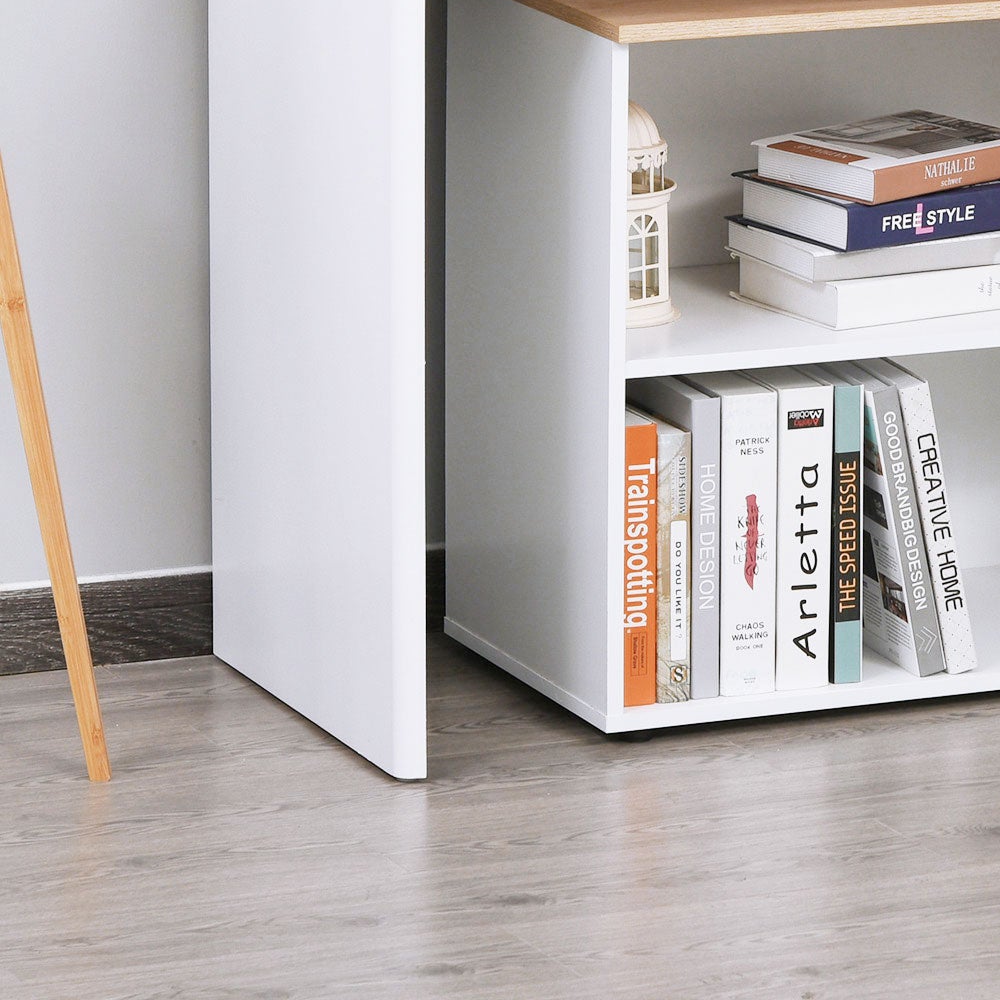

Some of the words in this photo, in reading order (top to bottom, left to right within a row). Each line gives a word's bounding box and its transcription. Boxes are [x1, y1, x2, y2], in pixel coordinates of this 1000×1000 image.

[924, 156, 977, 180] NATHALIE
[881, 212, 923, 233] FREE
[926, 204, 976, 227] STYLE
[735, 436, 770, 446] PATRICK
[740, 447, 765, 456] NESS
[678, 456, 686, 514] SIDESHOW
[699, 463, 716, 525] HOME
[839, 460, 857, 515] ISSUE
[917, 432, 953, 542] CREATIVE
[937, 548, 964, 612] HOME
[675, 541, 682, 558] DO
[790, 462, 819, 660] Arletta
[839, 518, 857, 575] SPEED
[838, 577, 856, 613] THE
[675, 618, 682, 629] IT
[731, 631, 769, 641] WALKING
[735, 621, 765, 631] CHAOS
